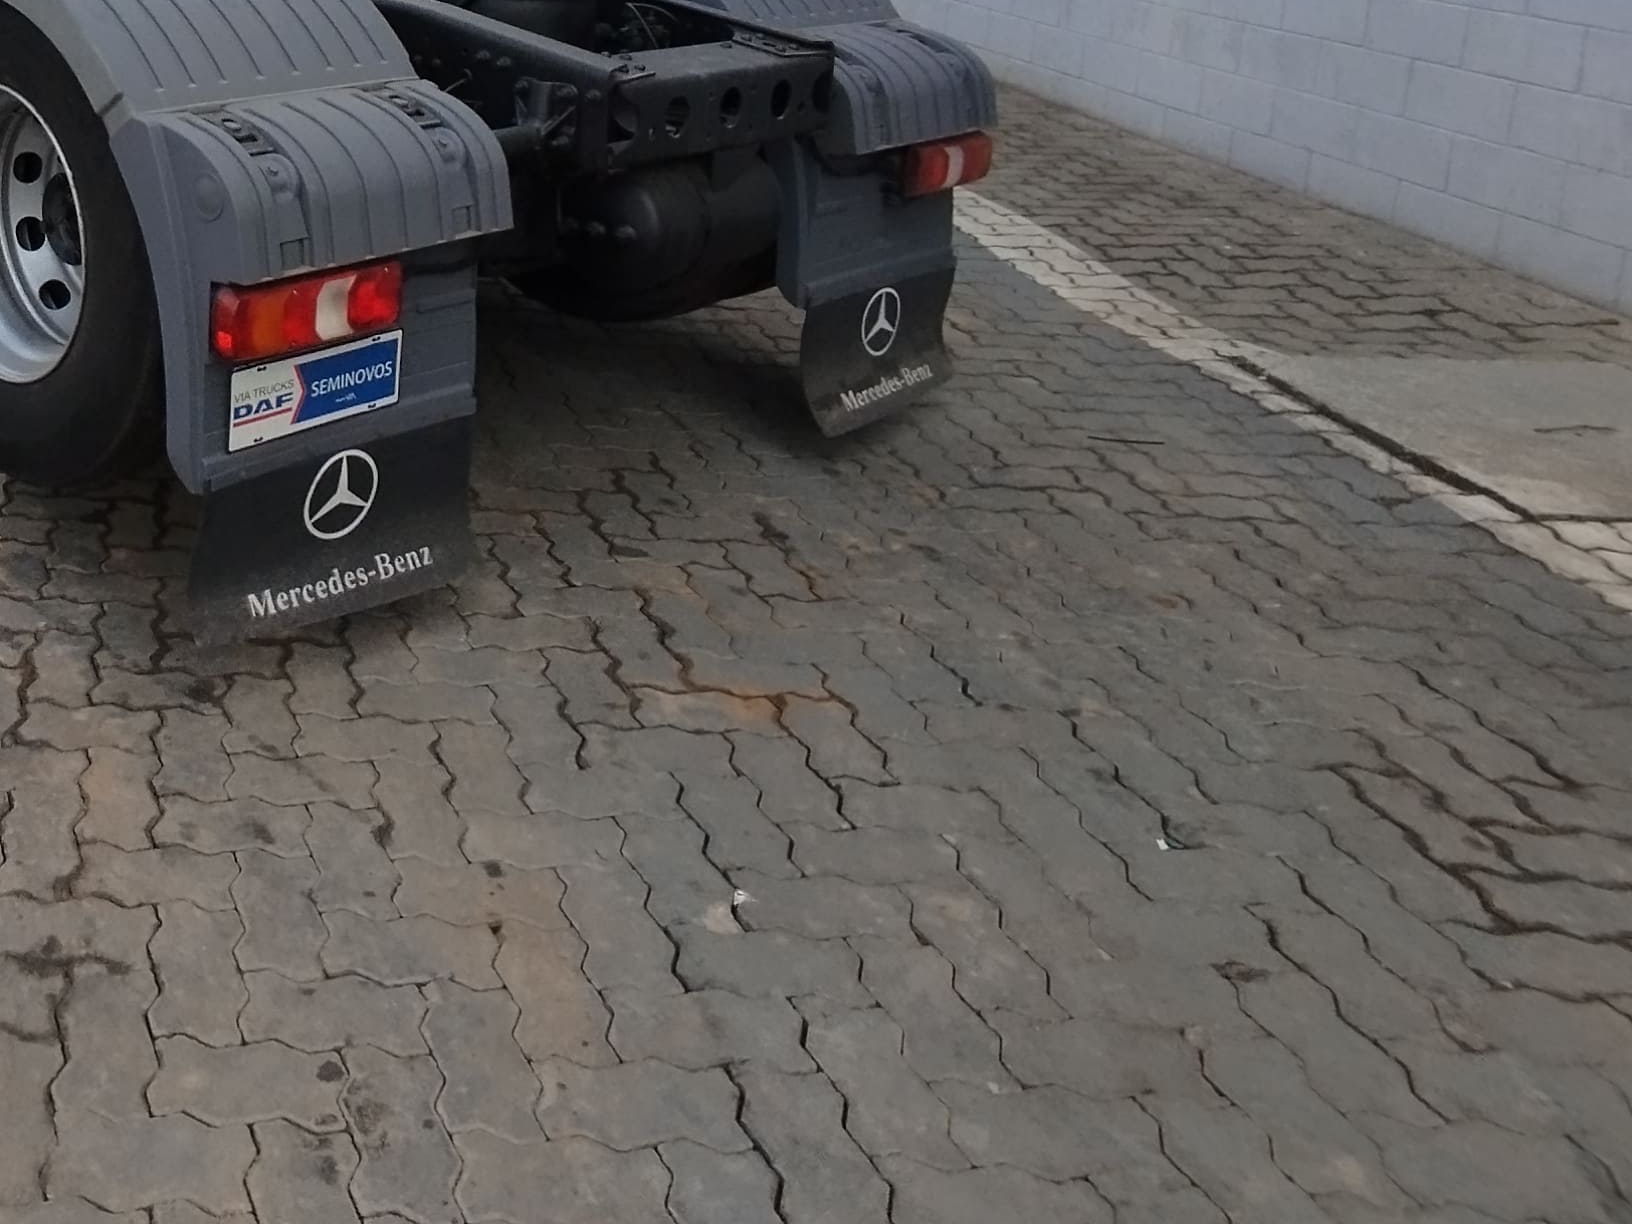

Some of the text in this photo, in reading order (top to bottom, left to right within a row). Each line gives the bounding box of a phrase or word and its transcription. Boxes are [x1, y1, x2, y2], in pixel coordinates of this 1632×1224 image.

[234, 378, 295, 404] VIA TRUCKS
[311, 360, 393, 398] SEMINOVOS
[839, 363, 935, 412] Mercedes-Benz
[233, 391, 294, 421] DAF
[247, 545, 434, 618] Mercedes-Benz
